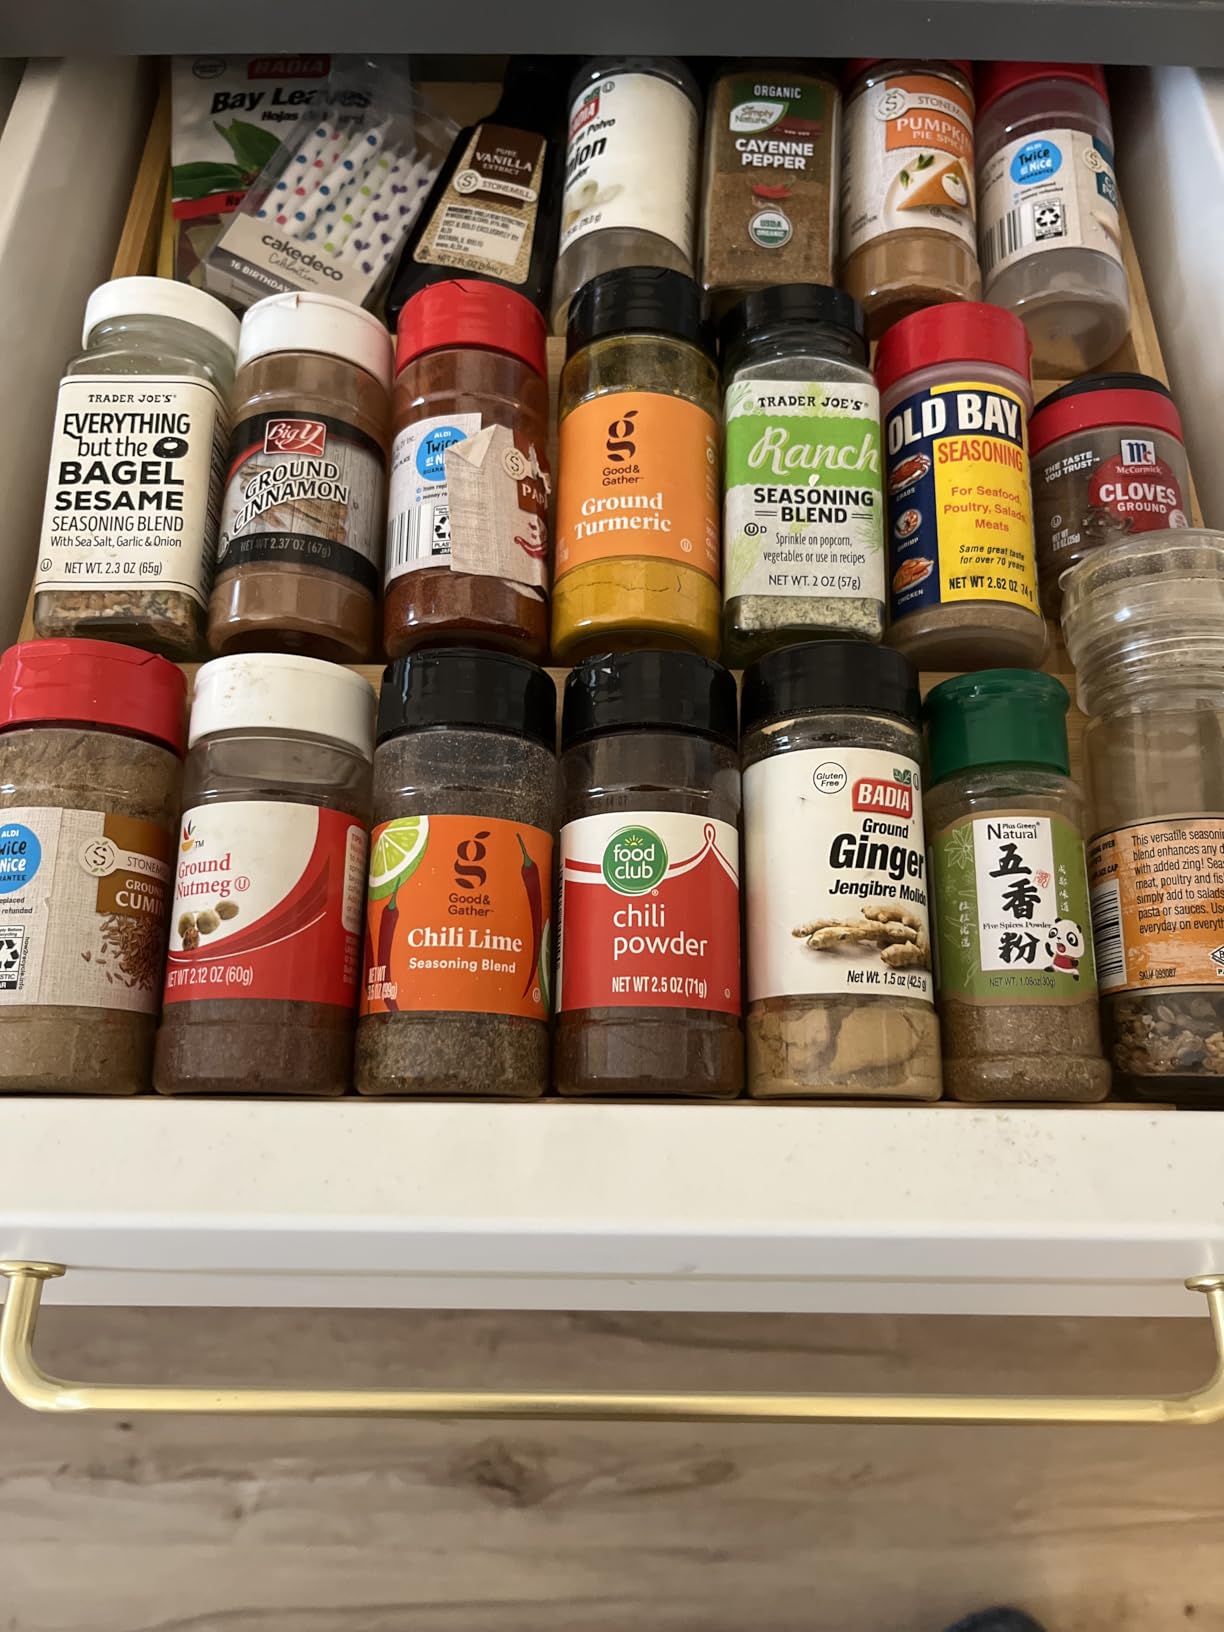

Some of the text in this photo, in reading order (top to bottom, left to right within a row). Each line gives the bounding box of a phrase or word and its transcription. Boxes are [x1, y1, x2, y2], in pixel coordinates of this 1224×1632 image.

[754, 85, 802, 99] ORGANIC
[210, 92, 266, 114] Bay
[261, 111, 299, 123] Hojas
[912, 131, 935, 140] PIE
[735, 138, 814, 156] CAYENNE
[475, 151, 532, 172] VANILLA
[741, 154, 806, 170] PEPPER
[482, 180, 533, 199] STONEMILL
[760, 220, 782, 229] USDA
[261, 235, 343, 281] cakedeco
[230, 260, 291, 293] 16 BIRTHDAY
[88, 394, 135, 403] TRADER
[758, 396, 816, 408] TRADER
[63, 413, 190, 437] EVERYTHING
[268, 423, 300, 444] Big
[888, 397, 947, 455] OLD
[433, 431, 451, 439] ALDI
[77, 436, 148, 457] but the
[748, 426, 879, 475] Ranch
[938, 439, 1023, 472] SEASONING
[1044, 451, 1093, 476] THE TASTE
[58, 461, 185, 485] BAGEL
[602, 465, 632, 476] Good
[1045, 470, 1062, 484] YOU
[1116, 465, 1162, 475] McCormick
[245, 460, 339, 500] GROUND
[602, 476, 640, 486] Gather
[54, 490, 184, 511] SESAME
[754, 487, 874, 507] SEASONING
[951, 485, 1022, 506] For Seafood,
[1099, 482, 1177, 506] CLOVES
[233, 480, 349, 535] CINNAMON
[581, 492, 663, 516] Ground
[1117, 502, 1167, 514] GROUND
[781, 506, 848, 524] BLEND
[944, 504, 1027, 525] Poultry, Salads,
[51, 516, 184, 532] SEASONING BLEND
[574, 513, 672, 541] Turmeric
[974, 519, 1010, 533] Meats
[50, 536, 182, 548] With Sea Salt, Garlic Onion
[270, 537, 332, 558] 2.37 (67g)
[776, 532, 853, 547] Sprinkle on popcorn,
[763, 550, 866, 565] vegetables or use recipes
[959, 545, 1024, 561] Same great taste
[64, 562, 163, 576] NET WT. 2.3 OZ (65g)
[960, 556, 972, 565] for
[996, 556, 1006, 566] 70
[1008, 558, 1025, 572] years
[768, 575, 861, 590] NET WT. OZ (57g)
[949, 578, 966, 590] NET
[969, 576, 985, 589] WT
[987, 576, 1007, 591] 2.62
[1009, 579, 1018, 593] OZ
[816, 772, 844, 781] Gluten
[858, 783, 910, 812] BADIA
[1, 829, 19, 838] ALDI
[862, 818, 909, 838] Ground
[987, 824, 1037, 840] Natural
[1131, 832, 1187, 846] This versatile
[613, 843, 655, 862] food
[829, 833, 924, 881] Ginger
[1133, 848, 1155, 861] blend
[1157, 845, 1200, 858] enhances
[1201, 845, 1217, 857] any
[178, 853, 231, 878] Ground
[615, 861, 654, 879] club
[1134, 859, 1204, 875] with added zing!
[177, 877, 232, 900] Nutmeg
[829, 879, 897, 899] Jengibre
[1135, 874, 1210, 890] meat, poultry and
[448, 892, 482, 905] Good
[989, 843, 1041, 964] 五香粉
[1136, 889, 1195, 905] simply add to
[448, 904, 490, 916] Gather
[613, 904, 665, 928] chili
[1138, 904, 1208, 920] pasta or sauces.
[983, 922, 1052, 930] Five Spices Powder
[1139, 920, 1191, 934] everyday on
[408, 926, 523, 952] Chili Lime
[613, 931, 708, 961] powder
[409, 957, 516, 973] Seasoning Blend
[177, 966, 254, 986] WT 2.12 OZ (60g)
[847, 970, 906, 986] Net Wt. 1.5 oz
[989, 977, 1004, 988] NET
[612, 976, 708, 998] NET WT 2.5 OZ (71g)
